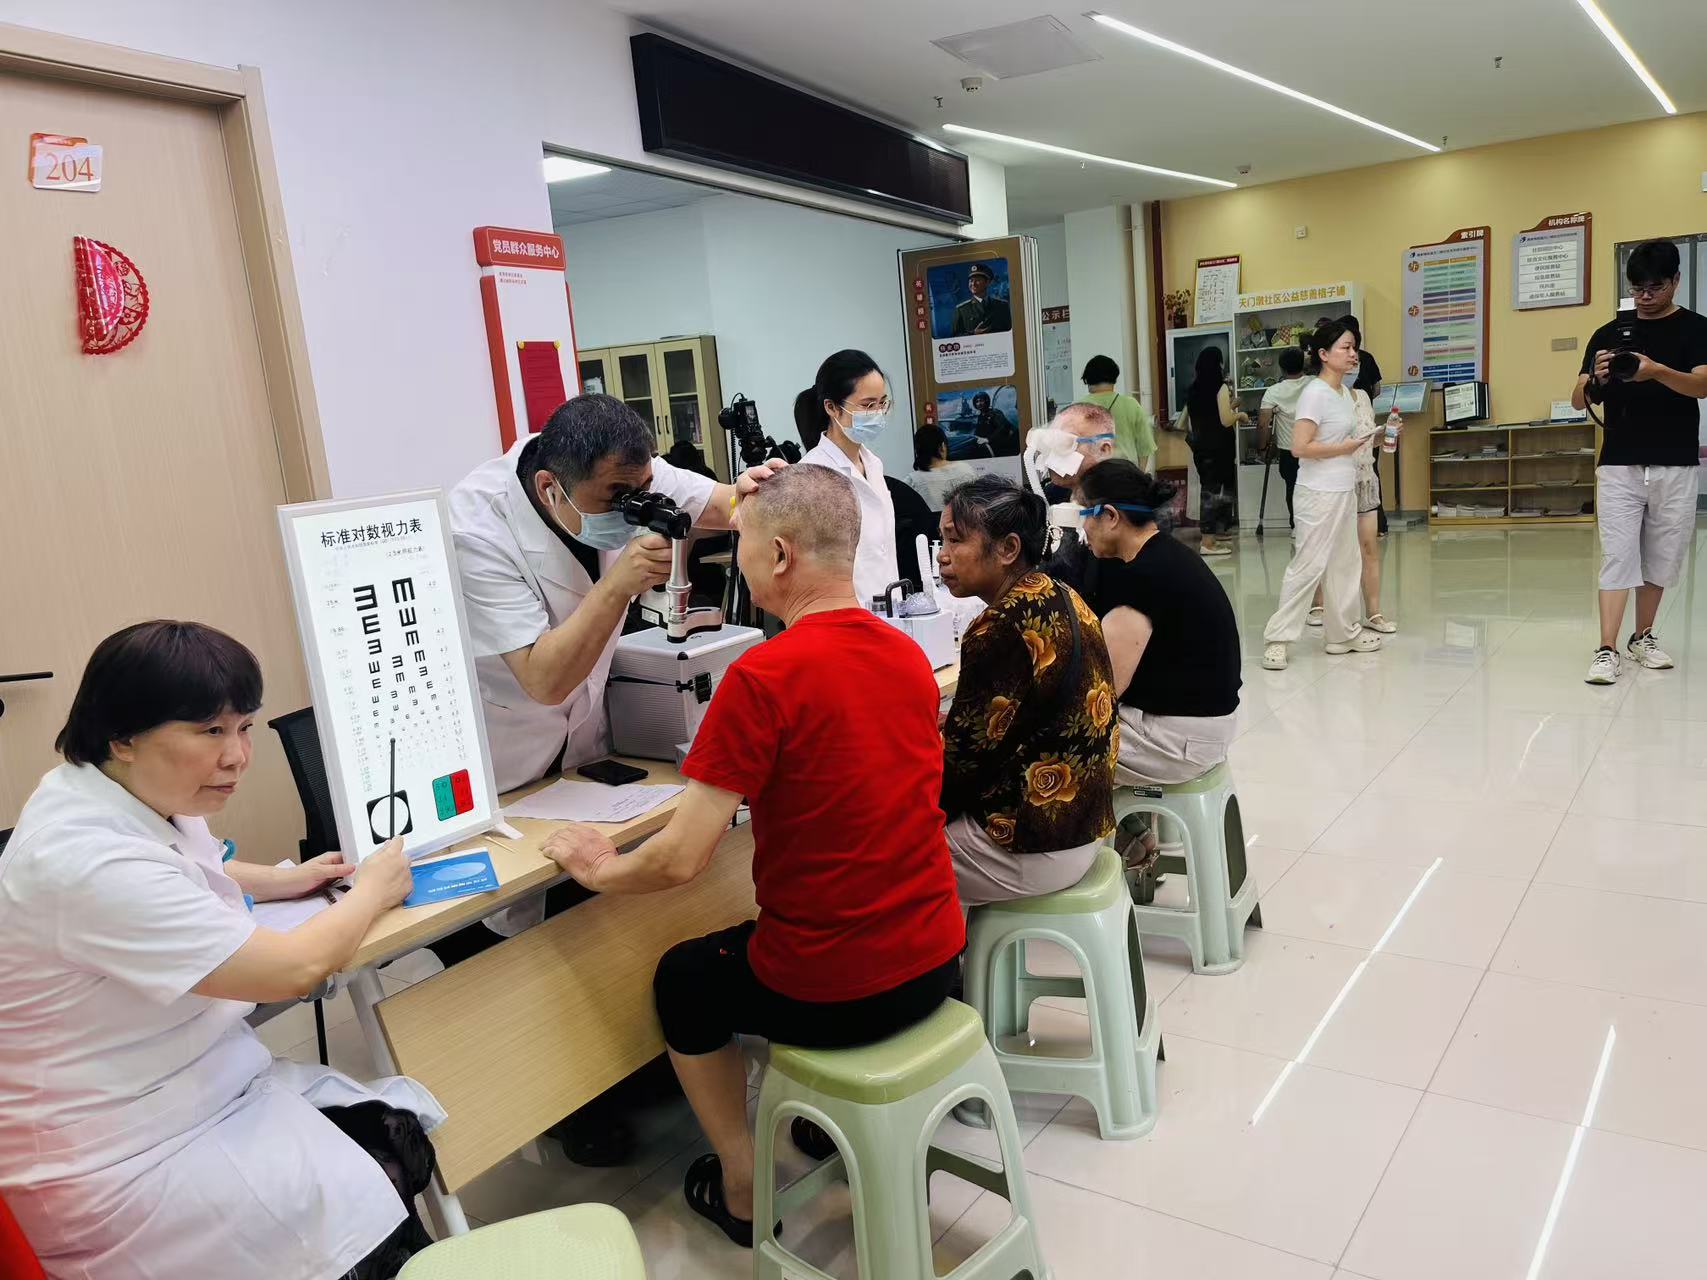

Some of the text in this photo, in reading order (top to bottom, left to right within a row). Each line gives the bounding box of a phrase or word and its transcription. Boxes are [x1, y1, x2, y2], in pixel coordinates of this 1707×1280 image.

[45, 152, 94, 182] 204
[492, 239, 560, 259] 党员群众服务中心
[321, 518, 422, 548] 标准对数视力表
